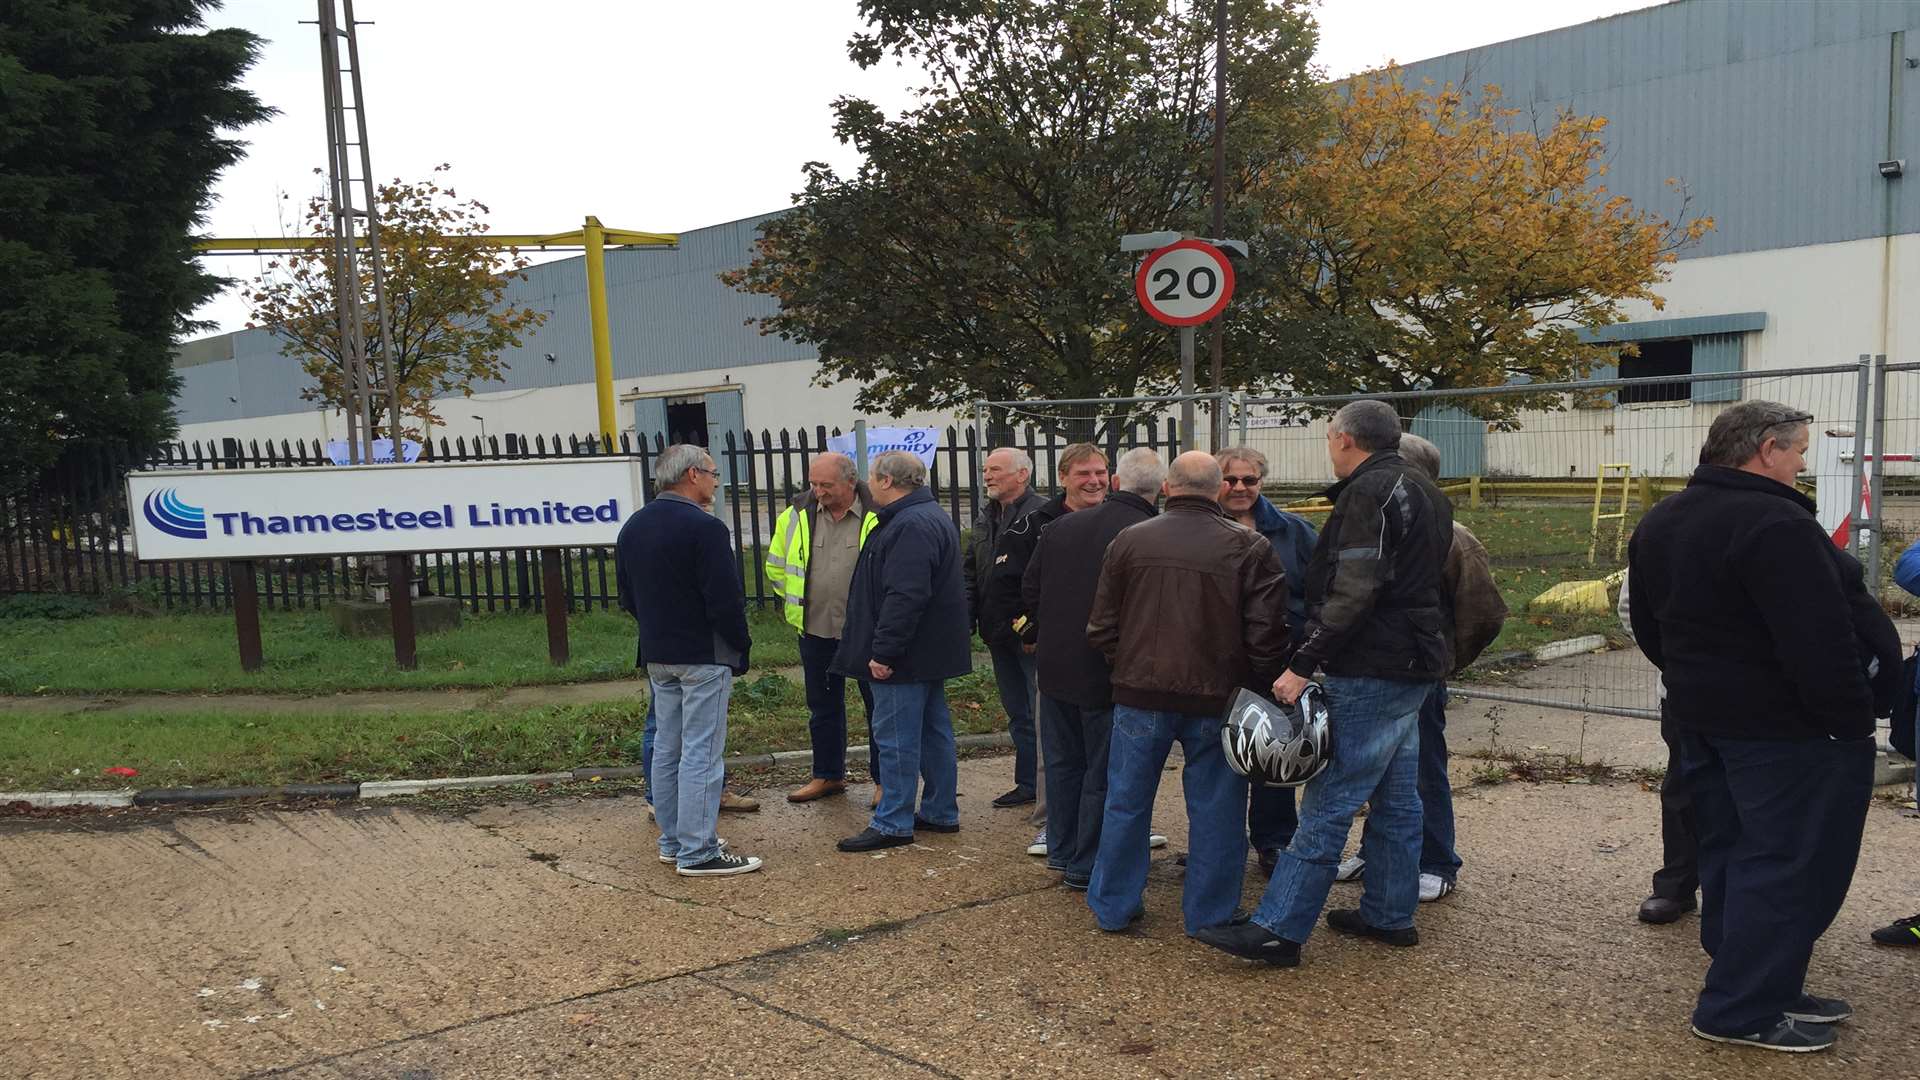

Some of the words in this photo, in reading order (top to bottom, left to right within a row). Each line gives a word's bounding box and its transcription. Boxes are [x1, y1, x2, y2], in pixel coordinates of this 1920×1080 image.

[1152, 266, 1217, 301] 20
[213, 505, 454, 536] Thamesteel
[468, 499, 620, 528] Limited
